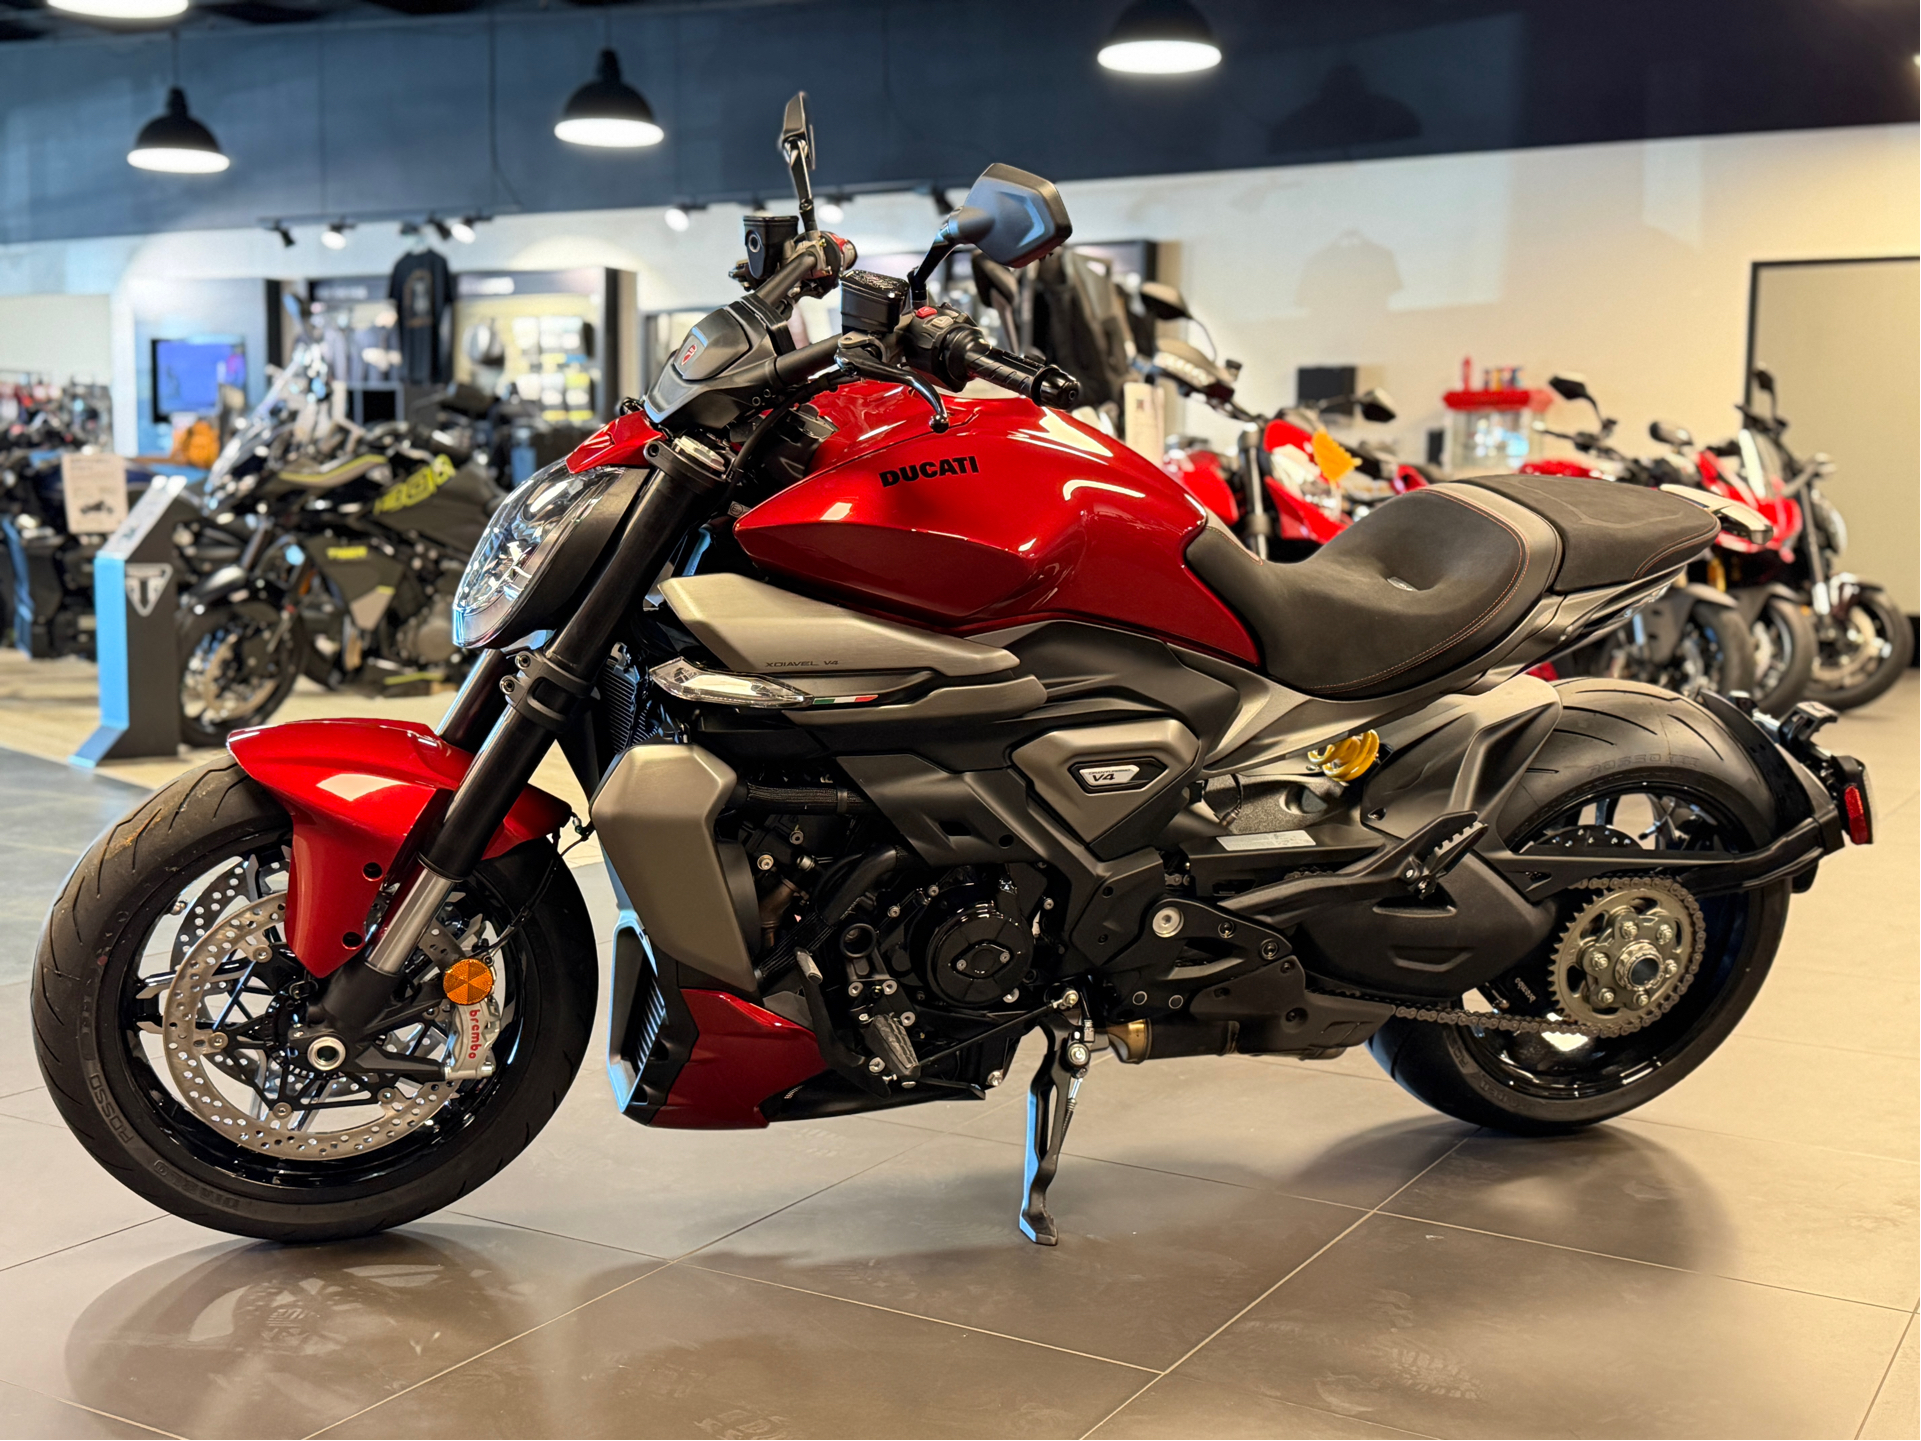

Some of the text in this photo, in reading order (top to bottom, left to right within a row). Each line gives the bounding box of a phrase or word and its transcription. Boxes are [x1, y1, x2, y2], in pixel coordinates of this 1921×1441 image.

[879, 456, 980, 488] DUCATI
[1092, 773, 1116, 782] V4
[468, 1009, 483, 1059] brembo
[90, 1073, 134, 1144] ROSSO
